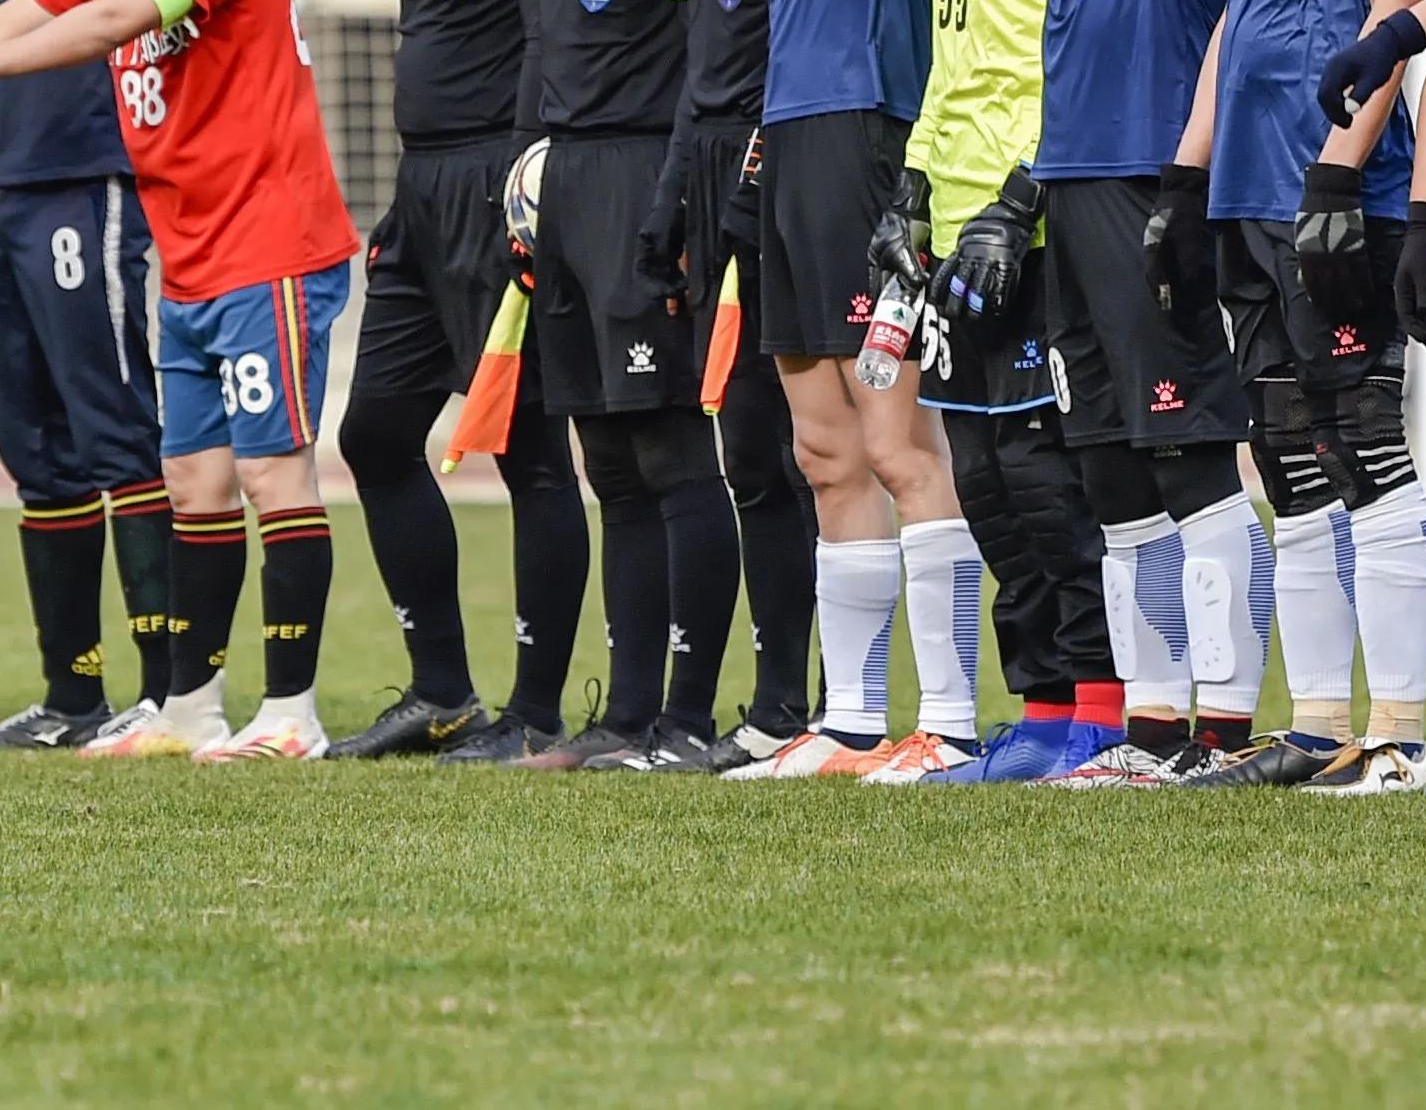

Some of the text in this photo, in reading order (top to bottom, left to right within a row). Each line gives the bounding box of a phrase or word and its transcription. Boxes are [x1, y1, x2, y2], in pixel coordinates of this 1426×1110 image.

[50, 226, 86, 290] 8
[1331, 344, 1367, 357] KELME
[1150, 400, 1184, 412] KELME
